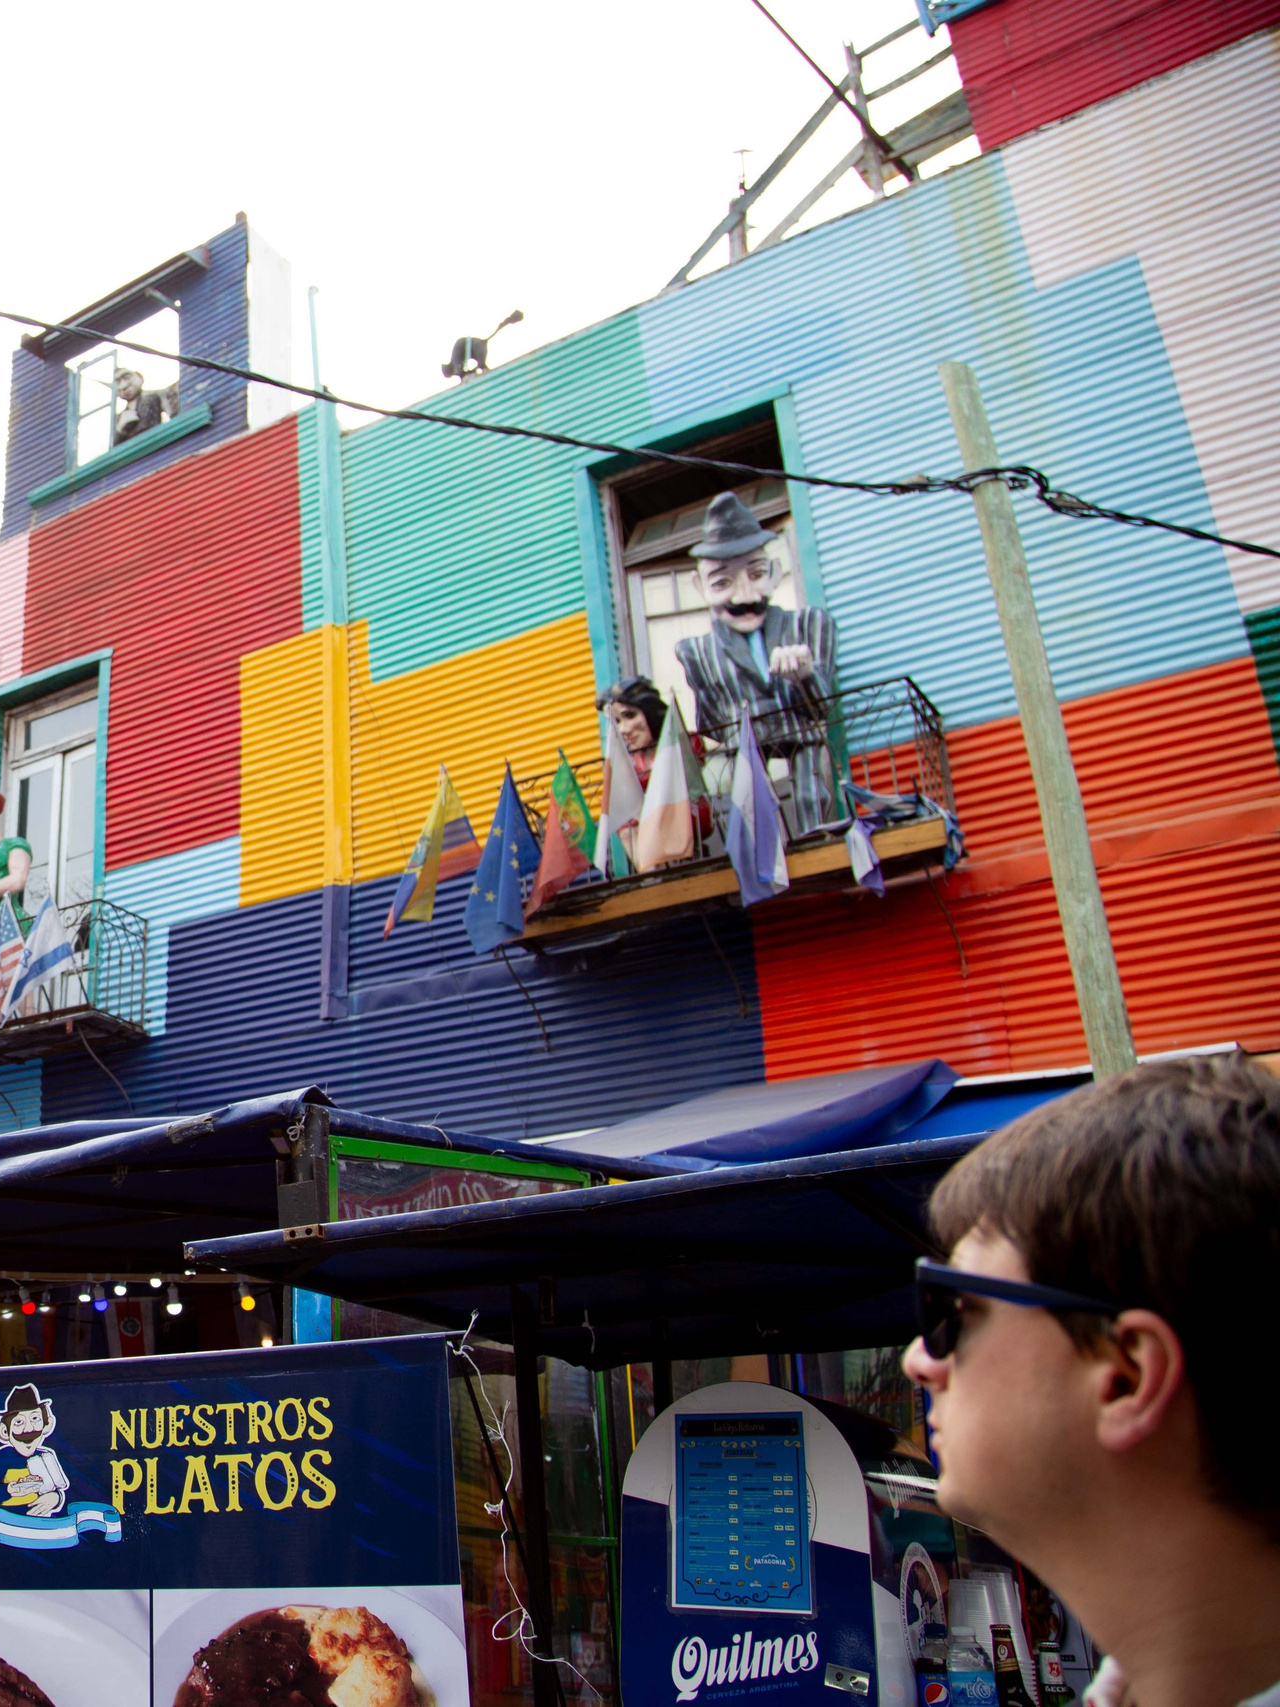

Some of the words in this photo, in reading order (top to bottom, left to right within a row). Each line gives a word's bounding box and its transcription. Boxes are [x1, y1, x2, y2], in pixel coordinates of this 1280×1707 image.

[109, 1396, 334, 1451] NUESTROS
[110, 1449, 336, 1515] PLATOS
[753, 1557, 787, 1567] PATAGONIA
[671, 1630, 820, 1703] Quilmes
[706, 1689, 746, 1701] CERVEZA
[748, 1680, 799, 1695] ARGENTINA
